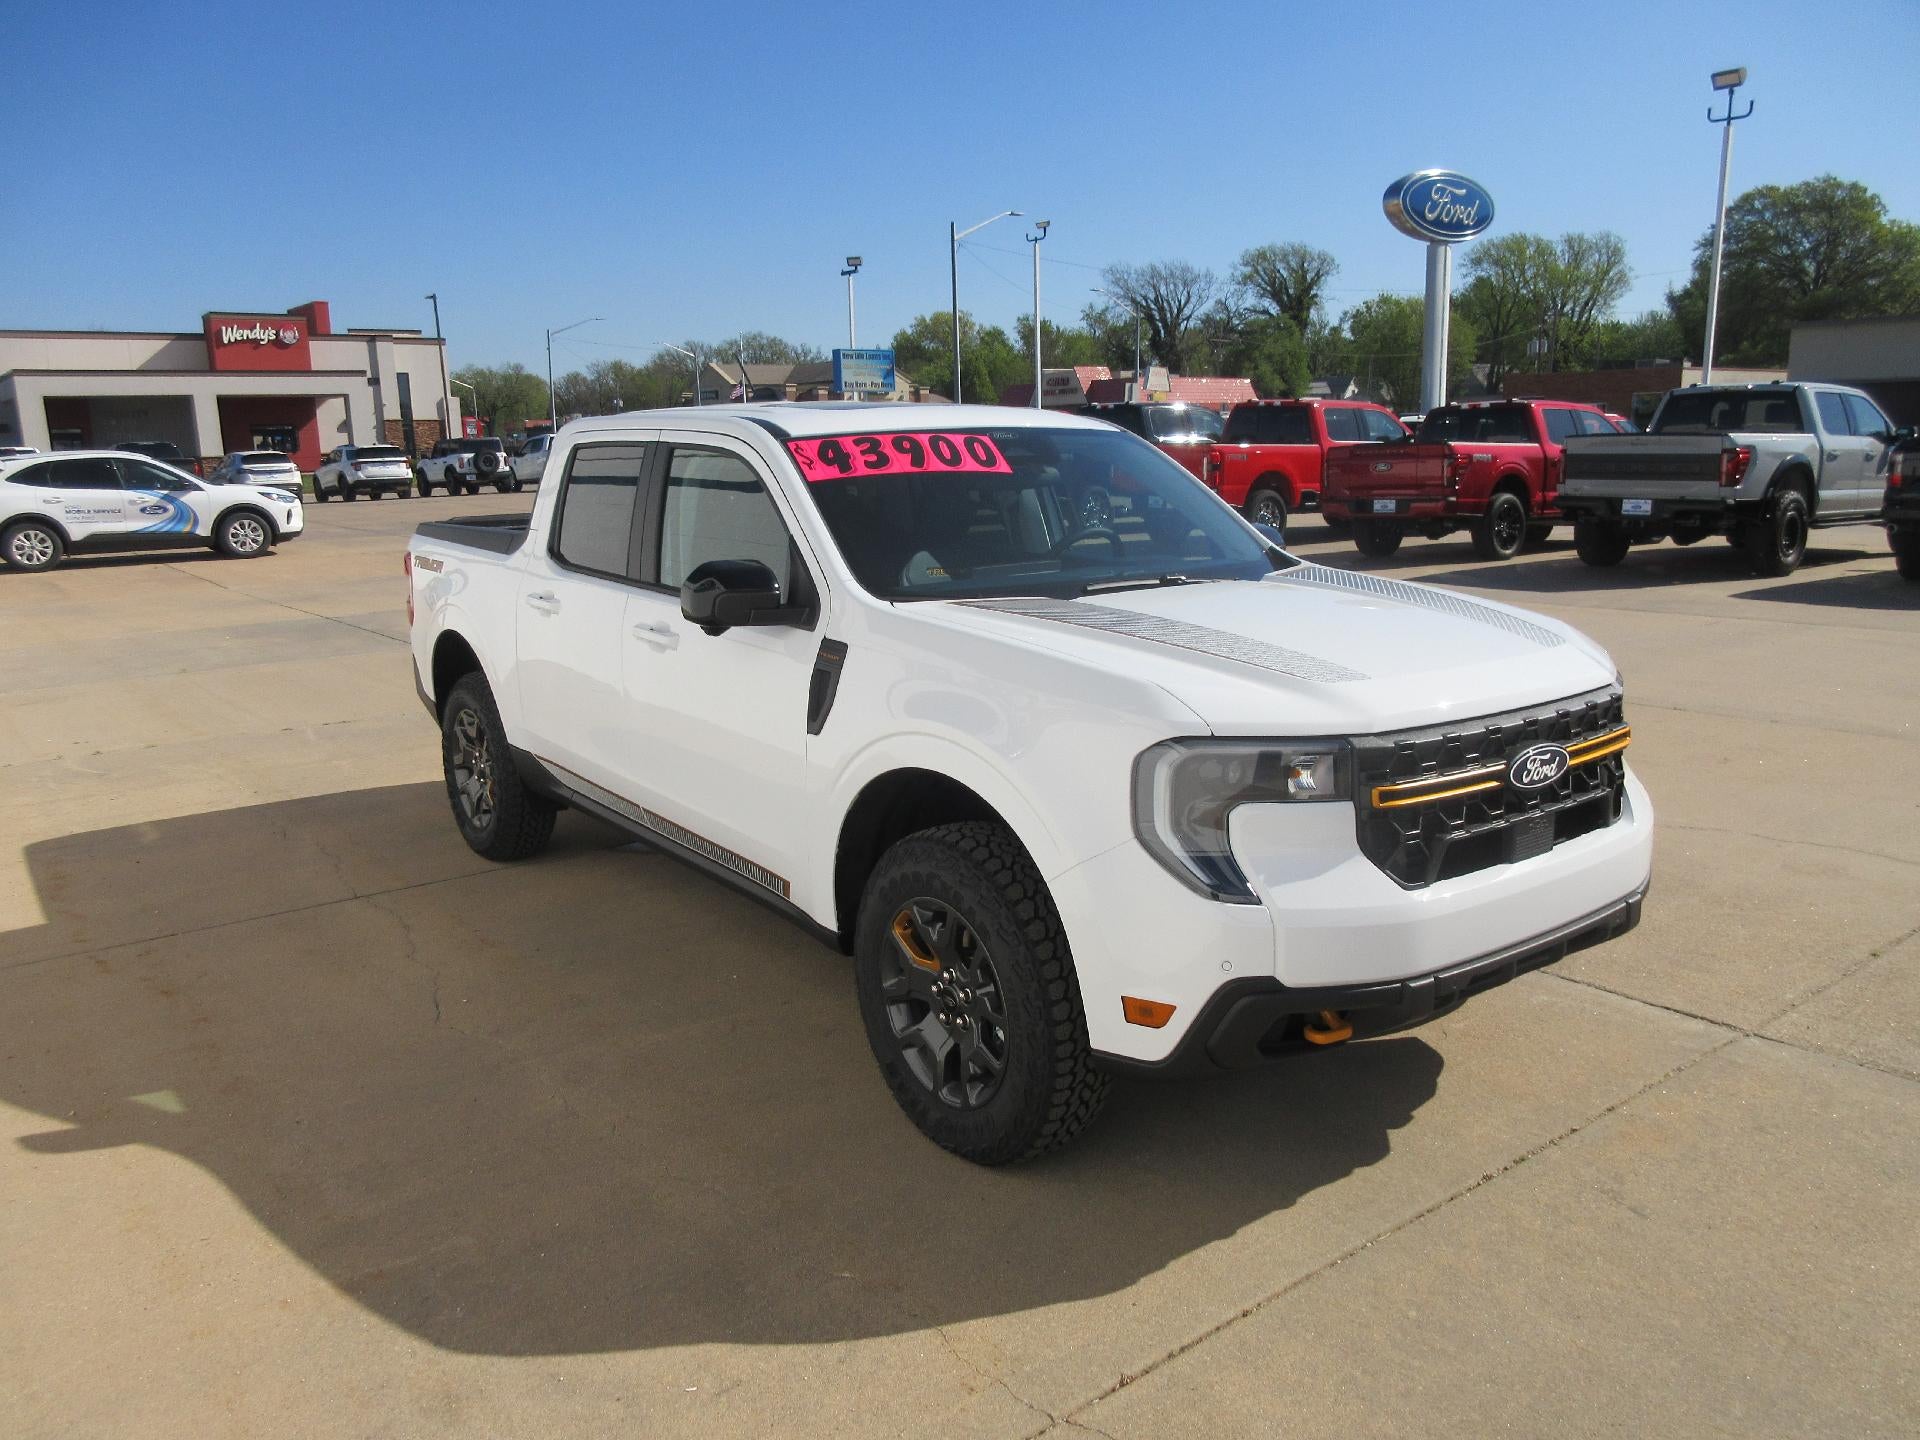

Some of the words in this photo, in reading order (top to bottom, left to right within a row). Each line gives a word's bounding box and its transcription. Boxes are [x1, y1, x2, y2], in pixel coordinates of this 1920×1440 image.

[1425, 183, 1479, 226] Ford
[221, 322, 277, 345] Wendy's
[793, 434, 999, 475] $43900
[1522, 752, 1560, 784] Ford
